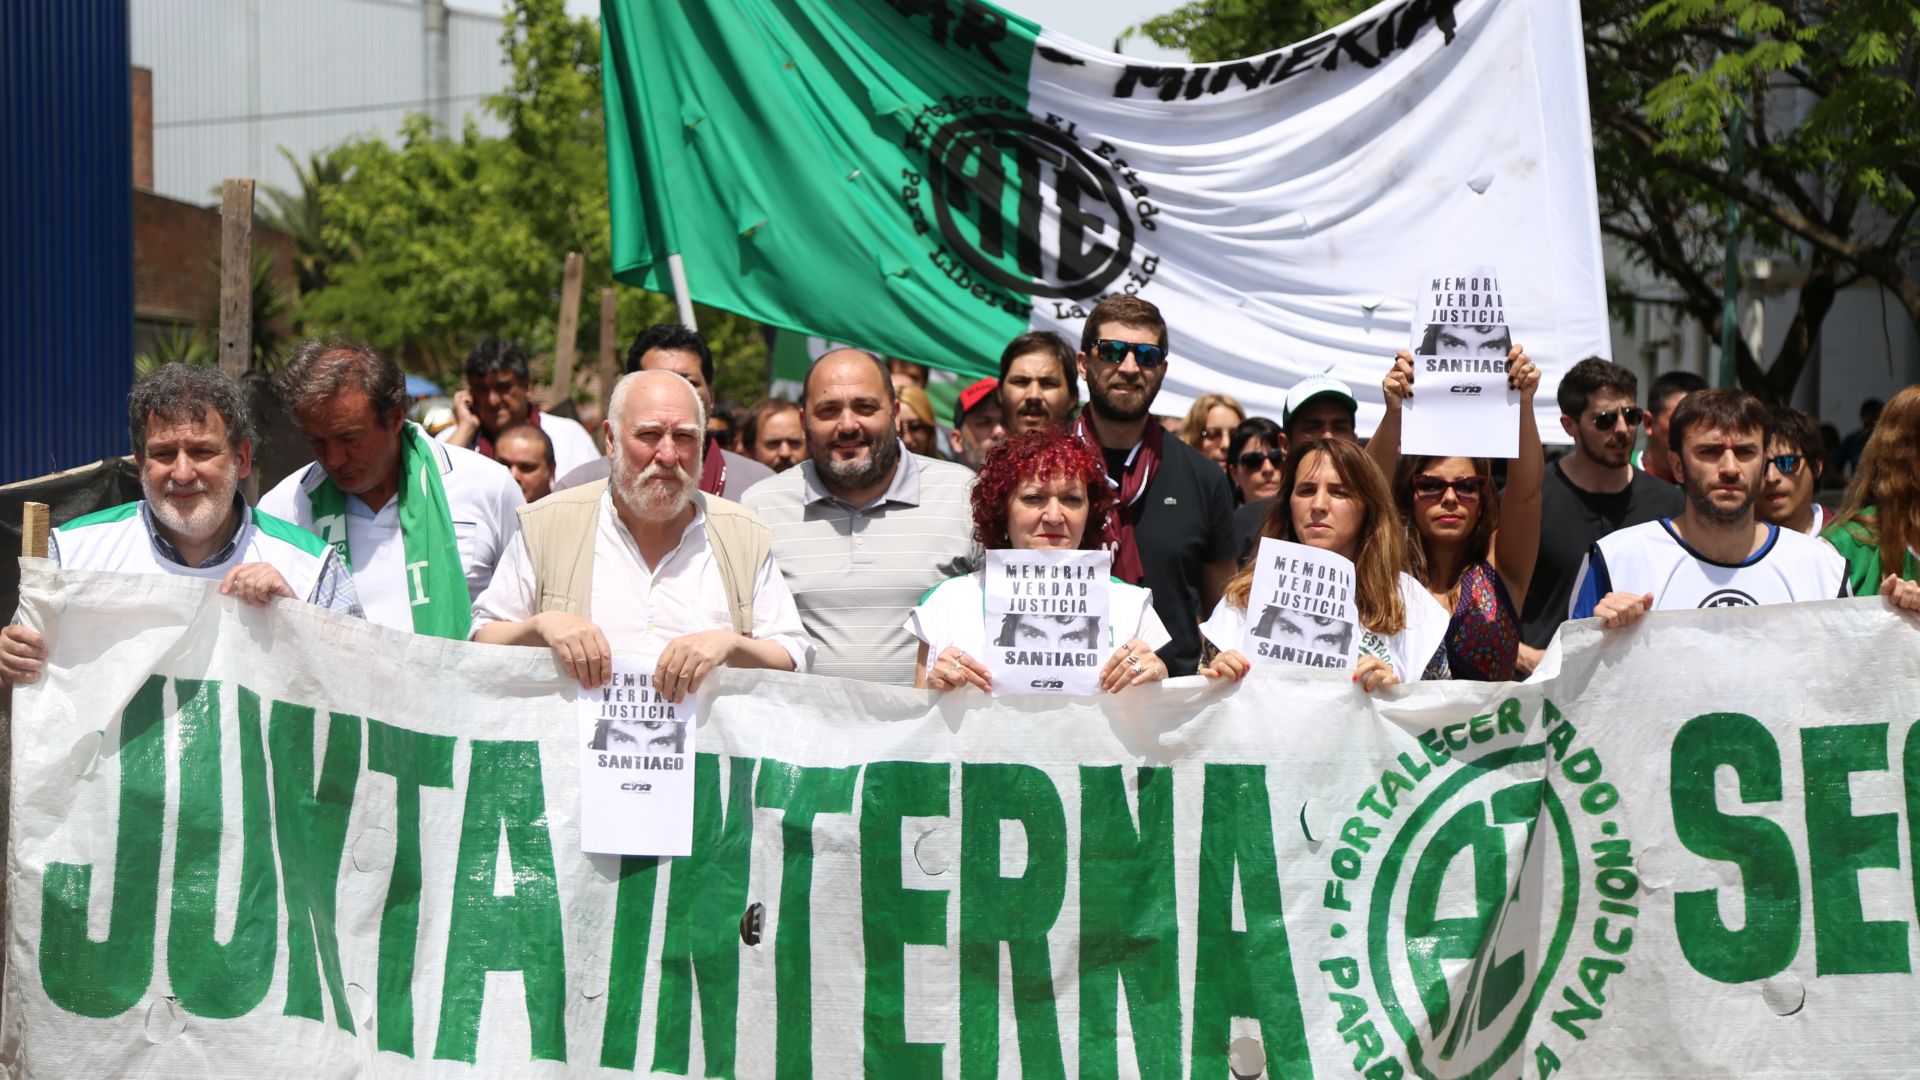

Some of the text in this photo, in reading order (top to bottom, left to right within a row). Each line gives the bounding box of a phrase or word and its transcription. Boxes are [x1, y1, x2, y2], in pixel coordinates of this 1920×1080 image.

[1092, 140, 1160, 232] Estado
[944, 128, 1120, 283] ATE
[902, 167, 930, 236] Para
[929, 245, 1034, 319] Liberar
[1052, 302, 1088, 320] La
[1431, 277, 1500, 292] MEMORI
[1431, 309, 1505, 323] JUSTICIA
[1005, 564, 1096, 580] MEMORIA
[1012, 582, 1088, 597] VERDAD
[1278, 574, 1347, 601] VERDAD
[1009, 598, 1087, 613] JUSTICIA
[1271, 590, 1346, 618] JUSTICIA
[1004, 651, 1098, 667] SANTIAGO
[1257, 641, 1347, 668] SANTIAGO
[601, 704, 675, 720] JUSTICIA
[598, 754, 684, 771] SANTIAGO
[1323, 697, 1525, 912] FORTALECER
[38, 674, 1920, 1080] JUNTA INTERNA SE
[1551, 838, 1640, 1040] NACION
